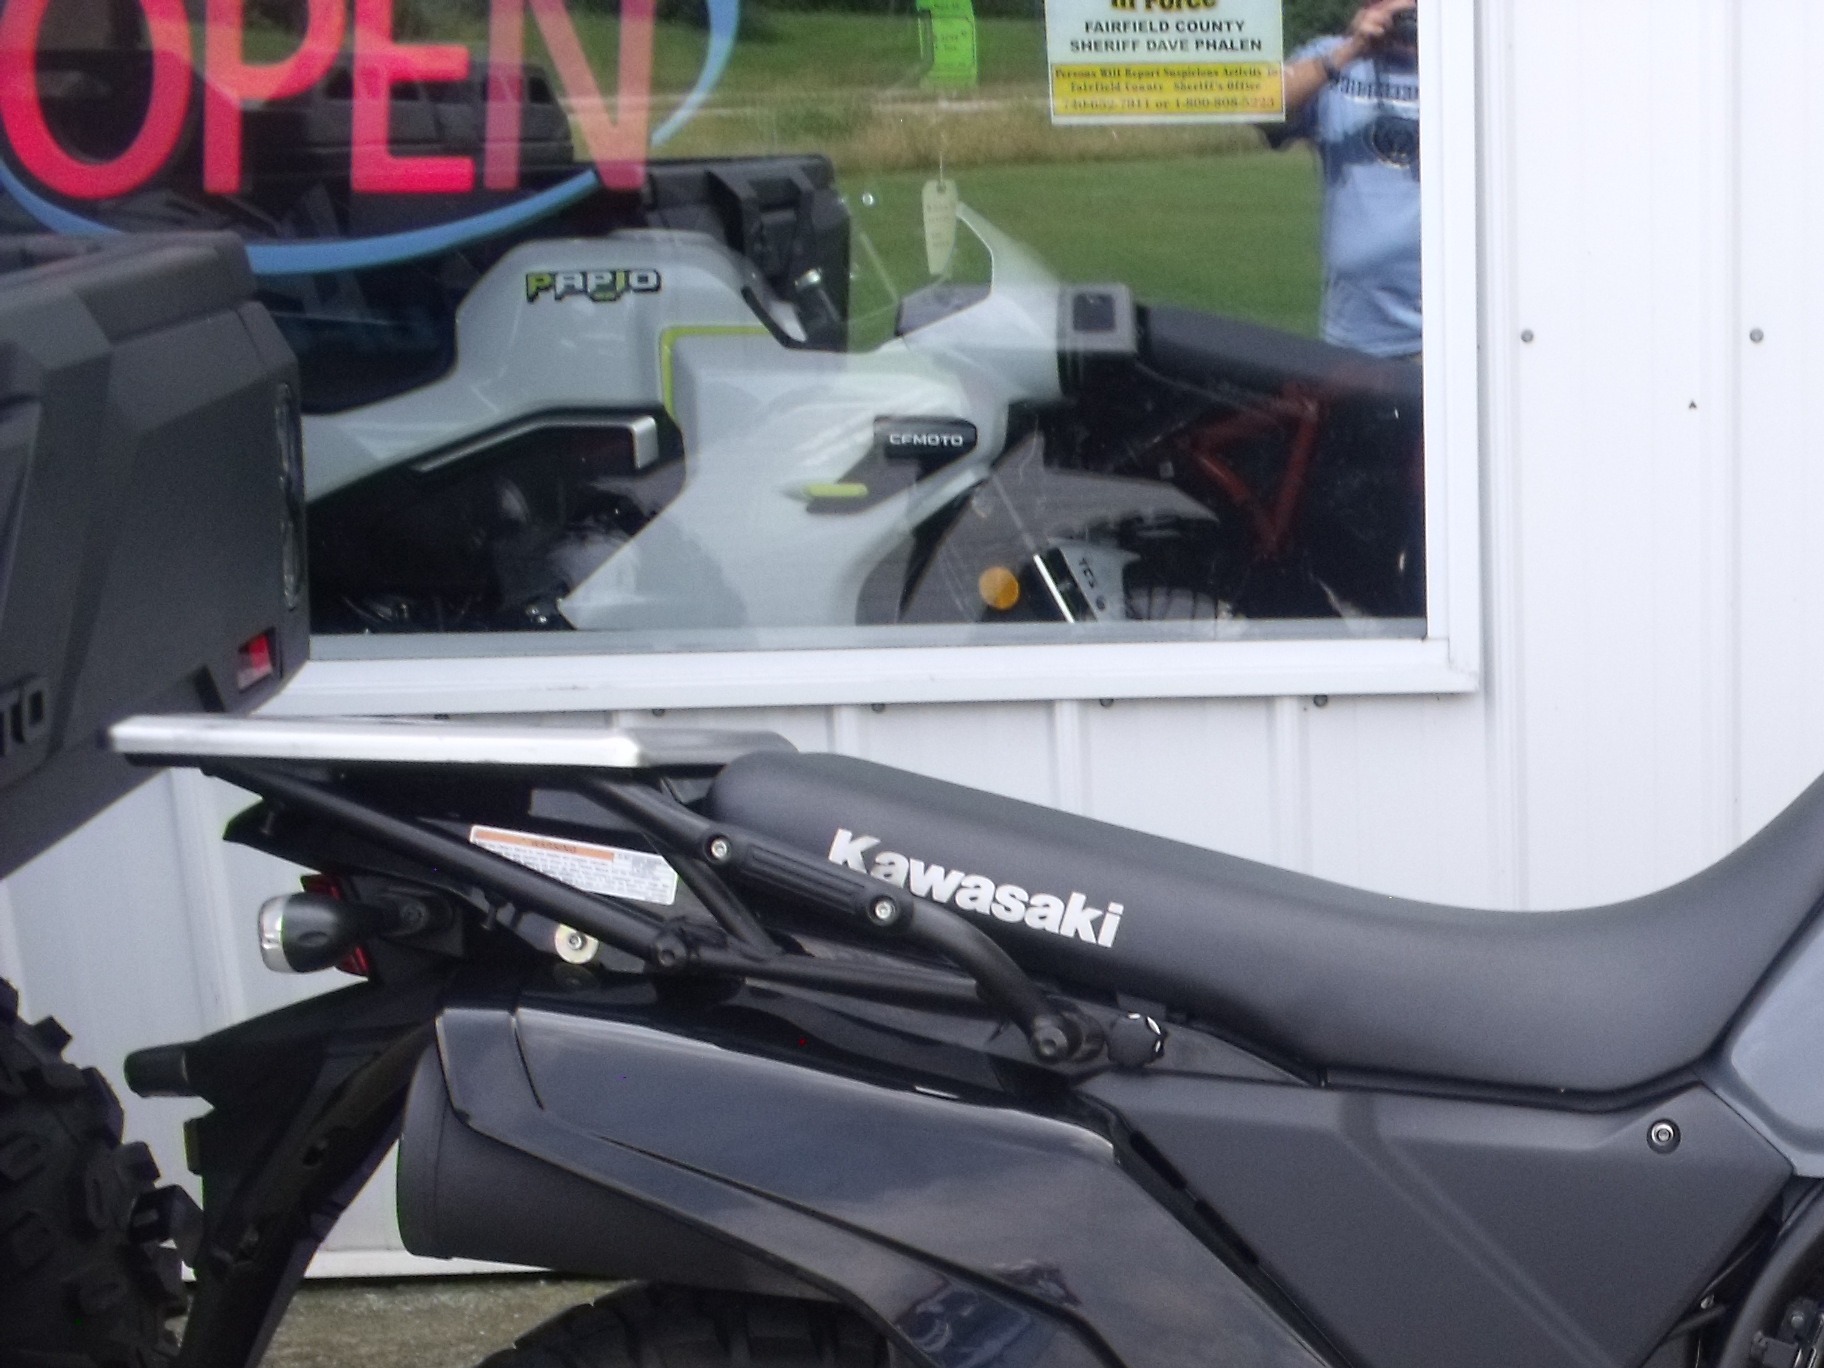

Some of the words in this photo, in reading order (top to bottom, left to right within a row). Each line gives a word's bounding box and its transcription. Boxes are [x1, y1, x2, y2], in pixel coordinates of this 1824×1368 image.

[1084, 20, 1170, 34] FAIRFIELD
[1175, 20, 1245, 34] COUNTY
[1069, 39, 1141, 53] SHERIFF
[1146, 39, 1190, 53] DAVE
[1194, 38, 1262, 52] PHALEN
[0, 0, 657, 198] OPEN
[526, 269, 661, 303] PAPIO
[828, 828, 1124, 948] Kawasaki
